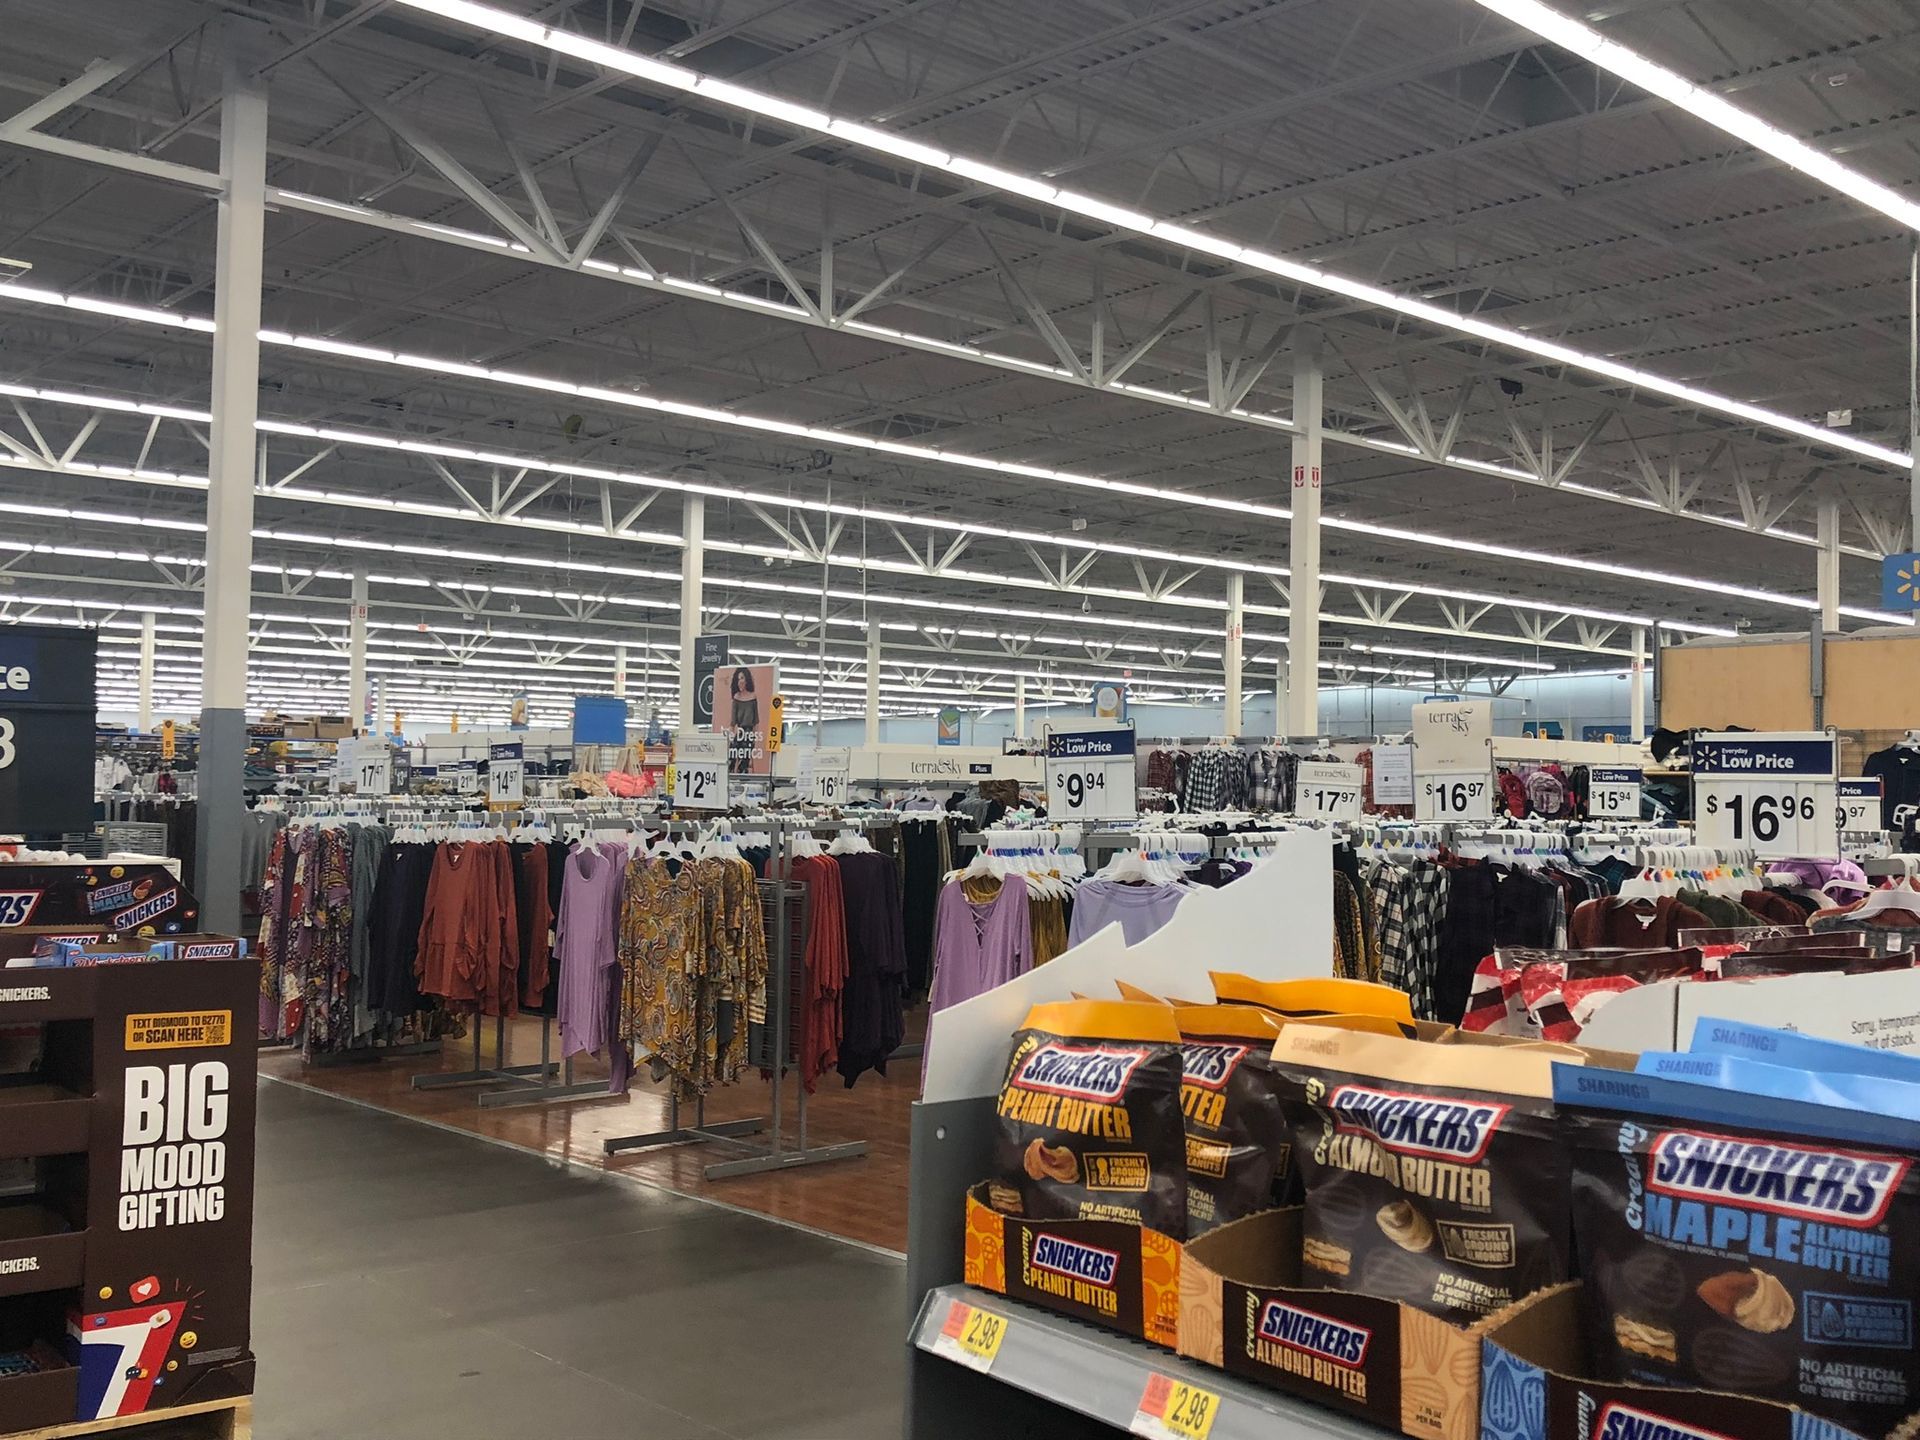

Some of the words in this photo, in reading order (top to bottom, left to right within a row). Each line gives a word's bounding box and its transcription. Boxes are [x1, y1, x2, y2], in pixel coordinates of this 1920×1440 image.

[705, 643, 718, 652] Fine
[701, 653, 721, 664] Jewelry
[737, 727, 763, 742] Dress
[771, 726, 778, 737] B
[1452, 720, 1469, 737] sky
[729, 743, 763, 759] merica
[769, 740, 778, 749] 17
[1066, 743, 1086, 753] Low
[1087, 741, 1112, 752] Price
[1721, 747, 1749, 755] Everyday
[975, 765, 988, 773] Plus
[1722, 755, 1752, 769] Low
[1755, 753, 1795, 769] Price
[1602, 773, 1614, 781] Low
[1841, 787, 1862, 795] Price
[117, 890, 175, 929] SNICKERS
[107, 934, 118, 943] 24
[187, 944, 233, 958] SNICKERS
[133, 1019, 151, 1029] TEXT
[153, 1017, 189, 1028] BIGMOOD
[191, 1016, 200, 1026] TO
[202, 1015, 225, 1025] 62770
[133, 1032, 144, 1042] OR
[145, 1028, 175, 1043] SCAN
[177, 1027, 203, 1041] HERE
[1712, 1028, 1769, 1052] SHARING
[1024, 1049, 1136, 1093] SNICKERS
[1656, 1059, 1713, 1076] SHARING
[1577, 1077, 1641, 1099] SHARING
[123, 1061, 229, 1146] BIG
[1000, 1086, 1060, 1128] PEANUT
[1056, 1097, 1132, 1138] BUTTER
[1334, 1089, 1494, 1154] SNICKERS
[120, 1142, 226, 1193] MOOD
[1110, 1157, 1145, 1167] FRESHLY
[1110, 1166, 1146, 1177] GROUND
[1617, 1121, 1648, 1231] creamy
[1656, 1134, 1892, 1215] SNICKERS
[1110, 1175, 1145, 1187] PEANUTS
[1401, 1156, 1492, 1207] BUTTER
[118, 1186, 225, 1232] GIFTING
[1080, 1201, 1092, 1212] NO
[1095, 1204, 1143, 1221] ARTIFICIAL
[1462, 1229, 1507, 1241] FRESHLY
[1645, 1192, 1802, 1264] MAPLE
[1804, 1222, 1891, 1257] ALMOND
[1464, 1239, 1509, 1252] GROUND
[1022, 1226, 1033, 1286] creamy
[1036, 1237, 1117, 1283] SNICKERS
[1802, 1244, 1889, 1280] BUTTER
[1030, 1267, 1073, 1293] PEANUT
[1074, 1286, 1118, 1312] BUTTER
[1438, 1273, 1454, 1286] NO
[1455, 1278, 1512, 1298] ARTIFICIAL
[1432, 1293, 1446, 1304] OR
[1246, 1291, 1260, 1359] creamy
[1264, 1305, 1365, 1362] SNICKERS
[1256, 1338, 1312, 1379] ALMOND
[1314, 1360, 1367, 1398] BUTTER
[1800, 1358, 1820, 1373] NO
[1824, 1362, 1906, 1384] ARTIFICIAL
[1799, 1383, 1817, 1396] OR
